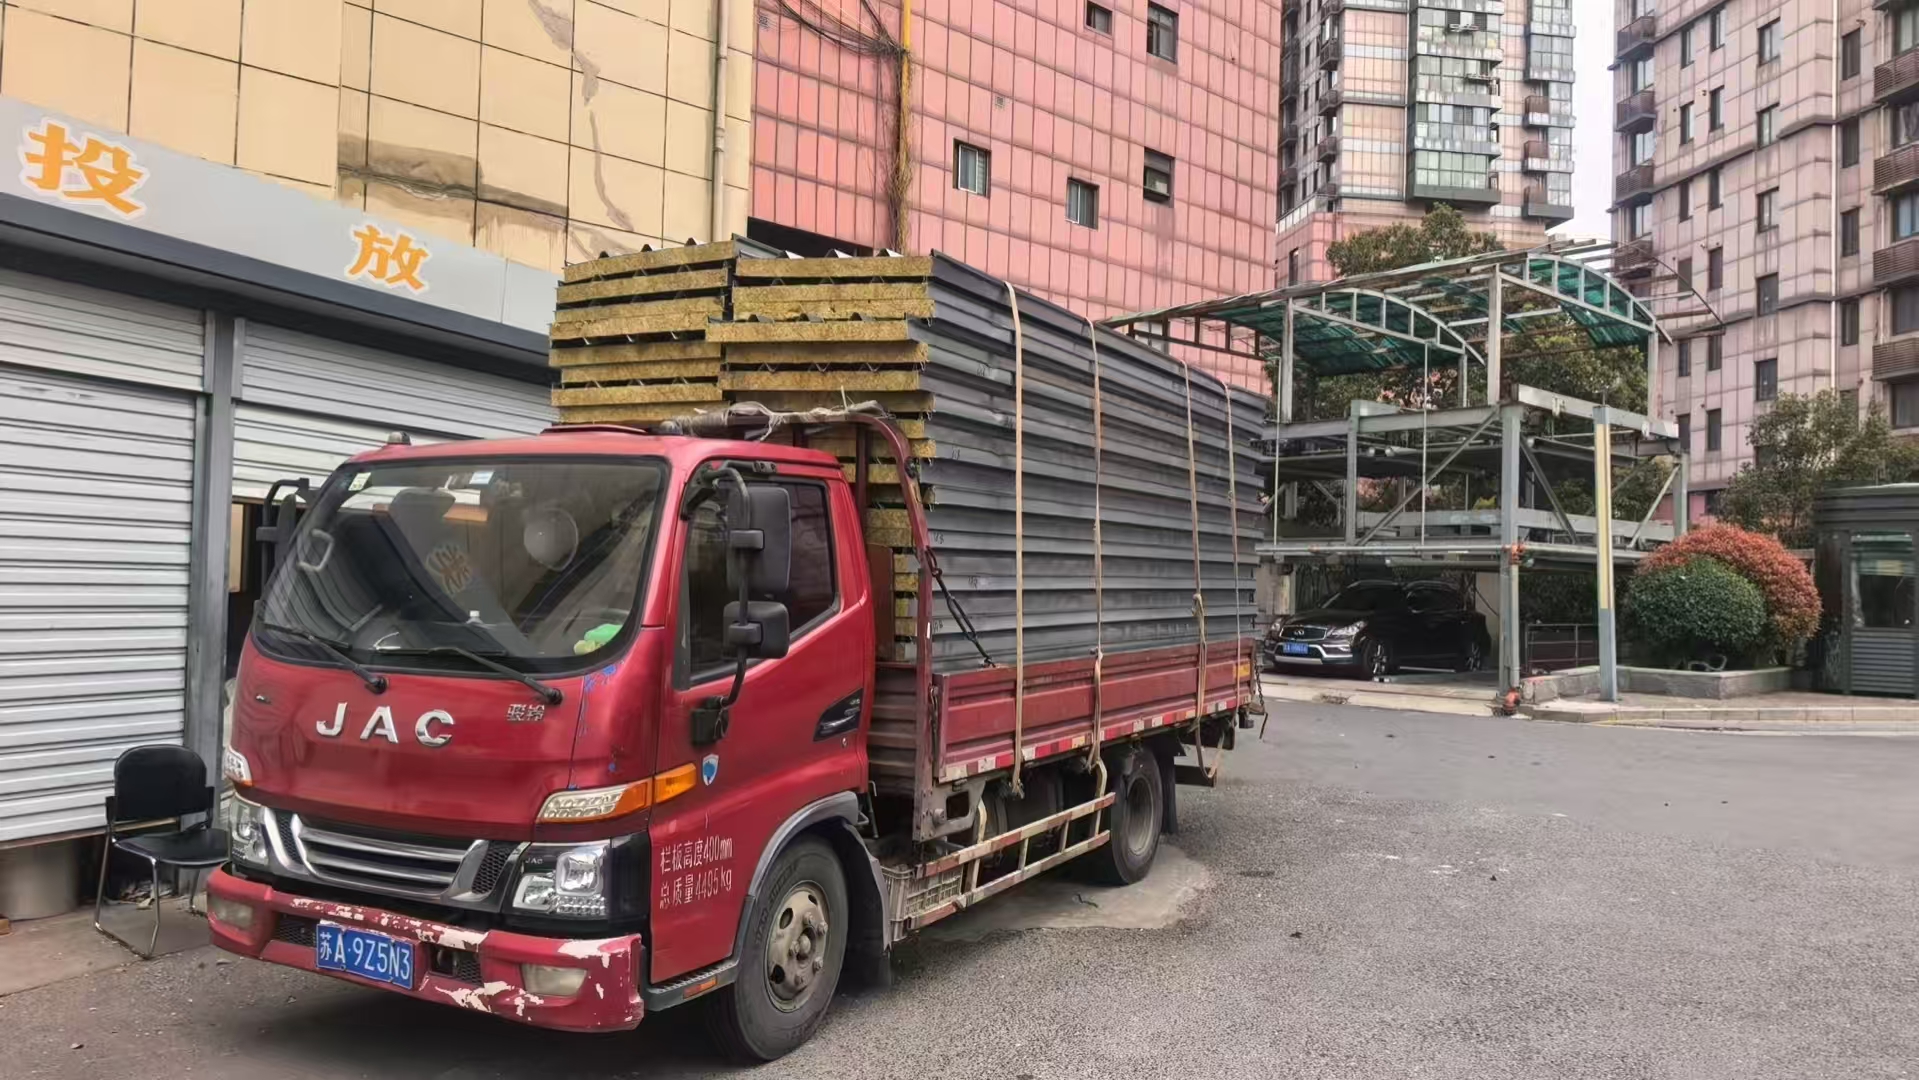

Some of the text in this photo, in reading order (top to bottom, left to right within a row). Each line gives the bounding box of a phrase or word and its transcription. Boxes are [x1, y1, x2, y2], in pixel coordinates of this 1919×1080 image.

[22, 119, 431, 291] 投 放
[316, 701, 455, 748] JAC
